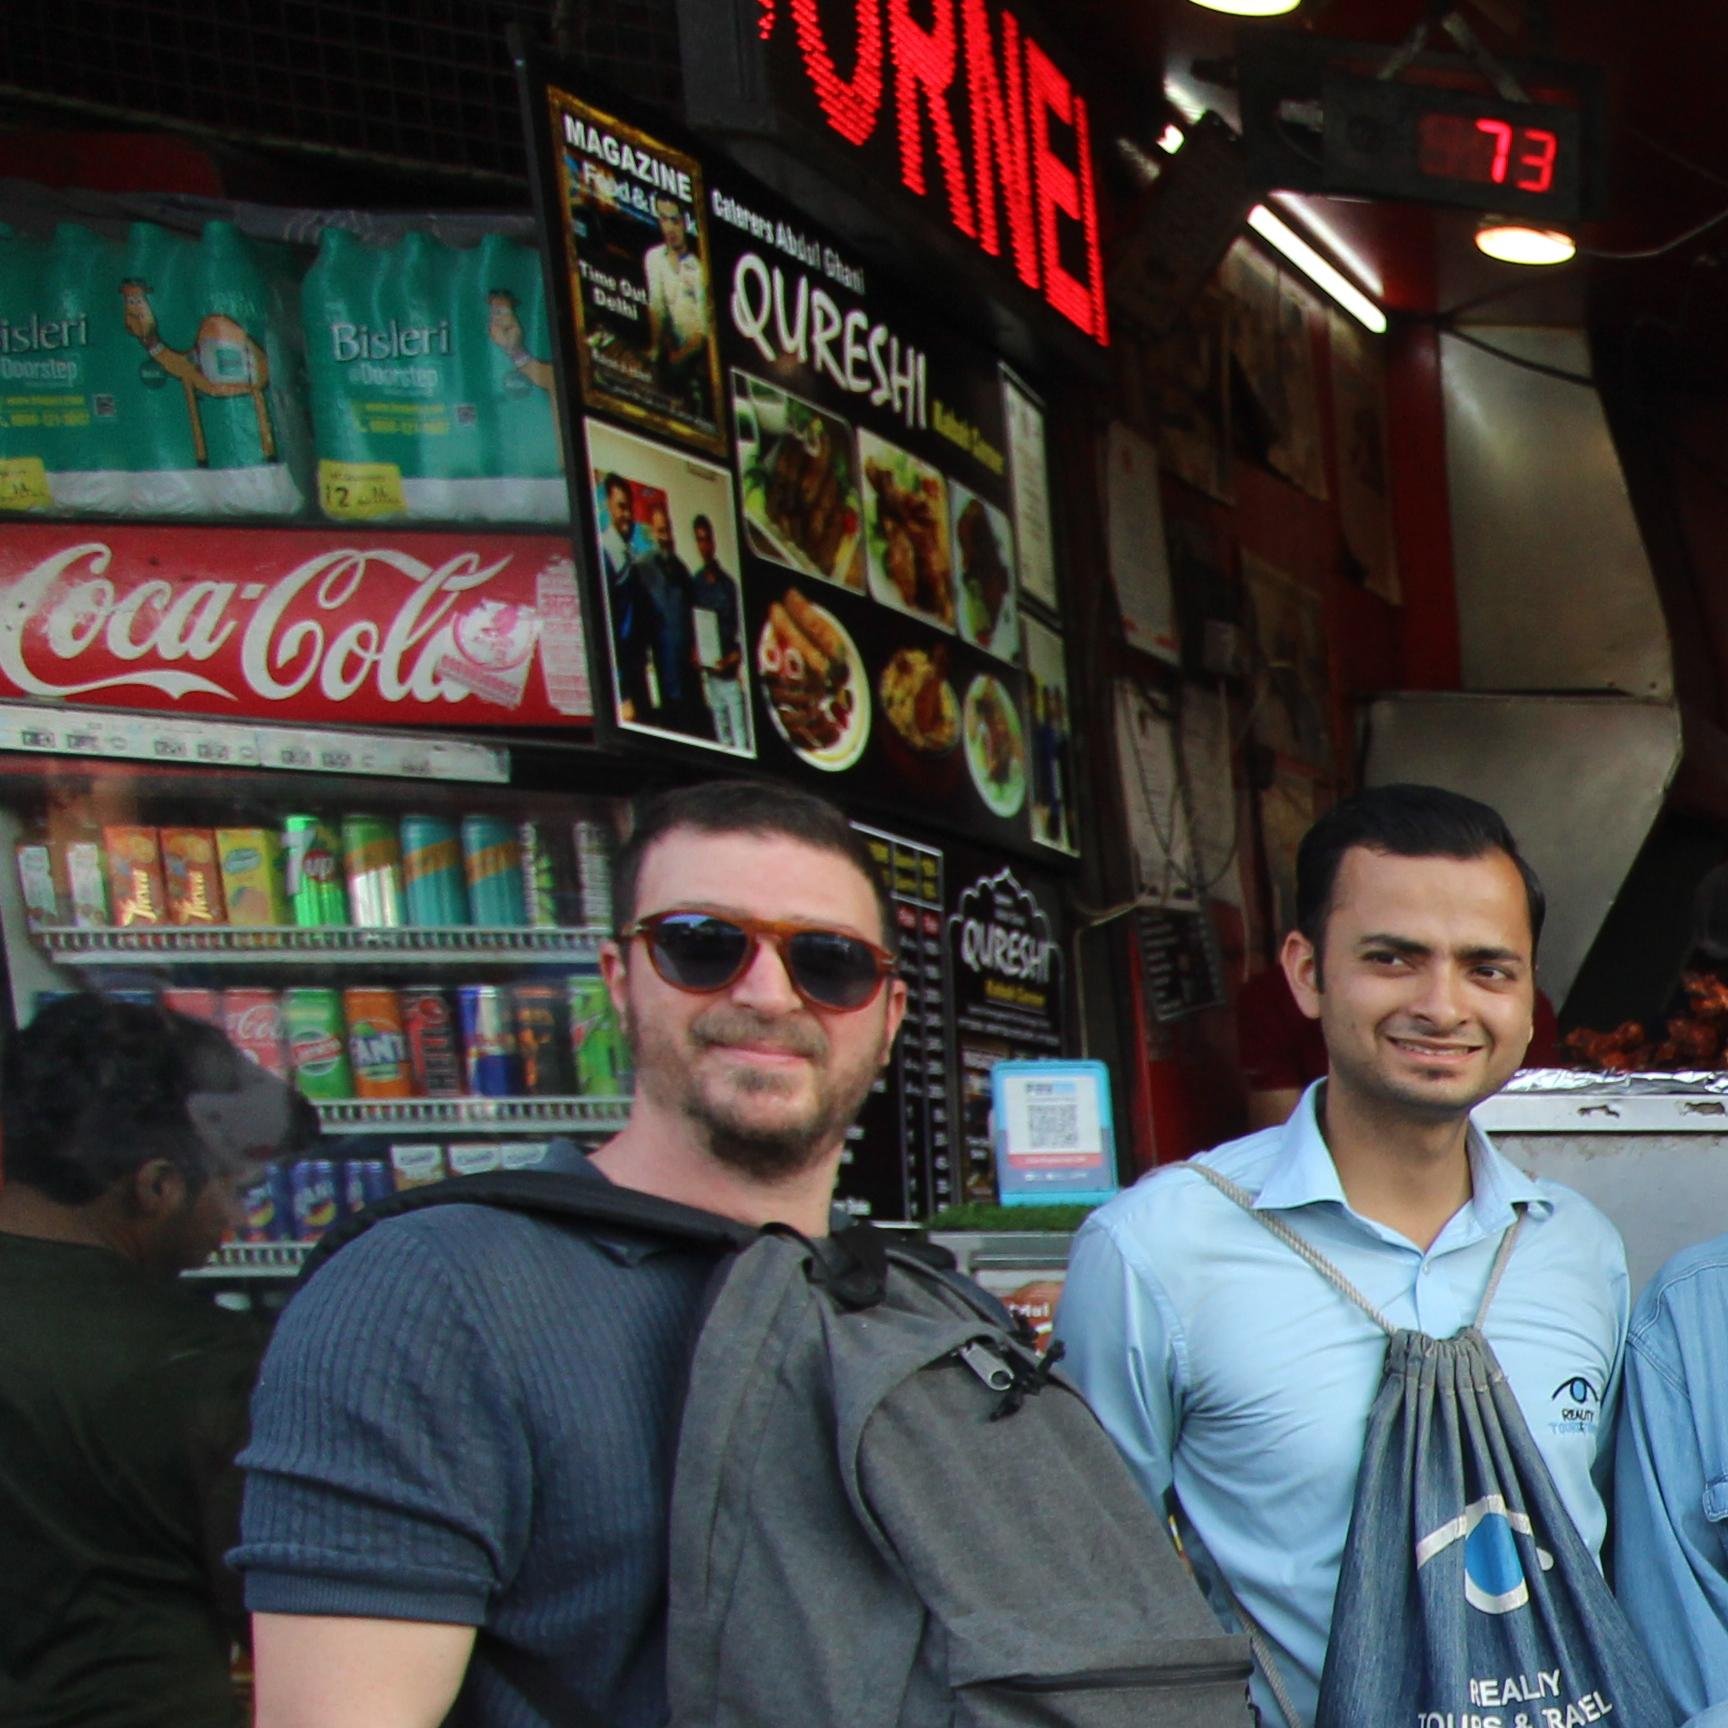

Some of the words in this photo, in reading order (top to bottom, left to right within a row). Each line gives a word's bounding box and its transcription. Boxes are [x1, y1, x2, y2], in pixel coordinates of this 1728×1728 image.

[563, 114, 693, 202] MAGAZINE
[1476, 118, 1557, 193] 73
[0, 313, 88, 352] isleri
[593, 290, 639, 321] Delhi
[331, 319, 450, 362] Bisleri
[731, 252, 928, 430] QURESHI
[961, 918, 1050, 984] QURESHI
